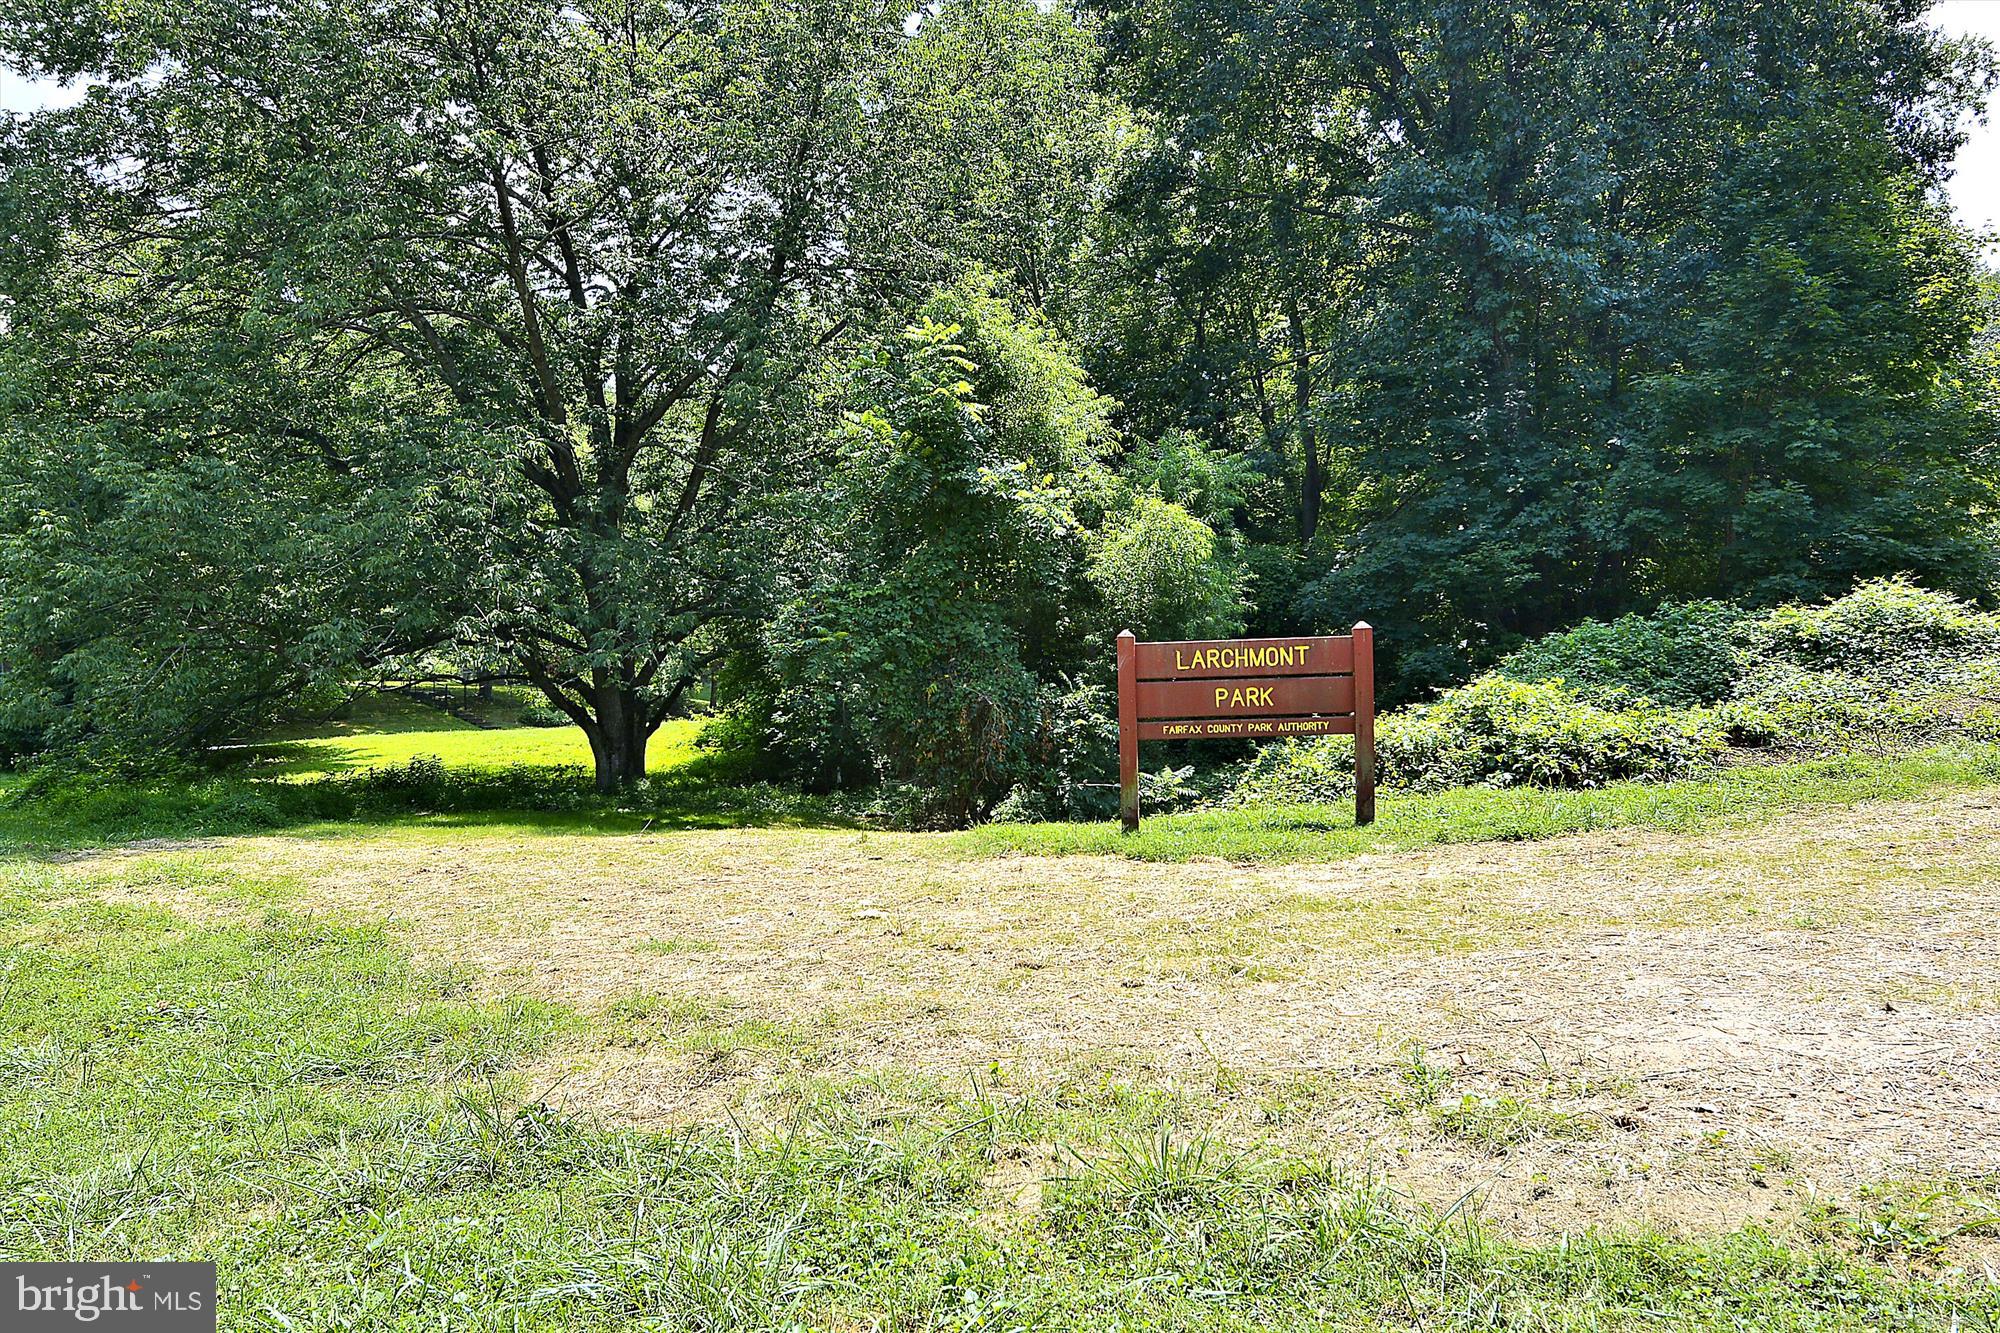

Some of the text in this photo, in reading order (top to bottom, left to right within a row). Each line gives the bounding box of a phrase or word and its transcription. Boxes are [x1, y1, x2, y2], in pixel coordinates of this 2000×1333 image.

[1176, 645, 1310, 671] LARCHMONT
[1214, 686, 1275, 708] PARK
[1162, 721, 1330, 735] FAIRFAX COUNTY PARK AUTHORITY
